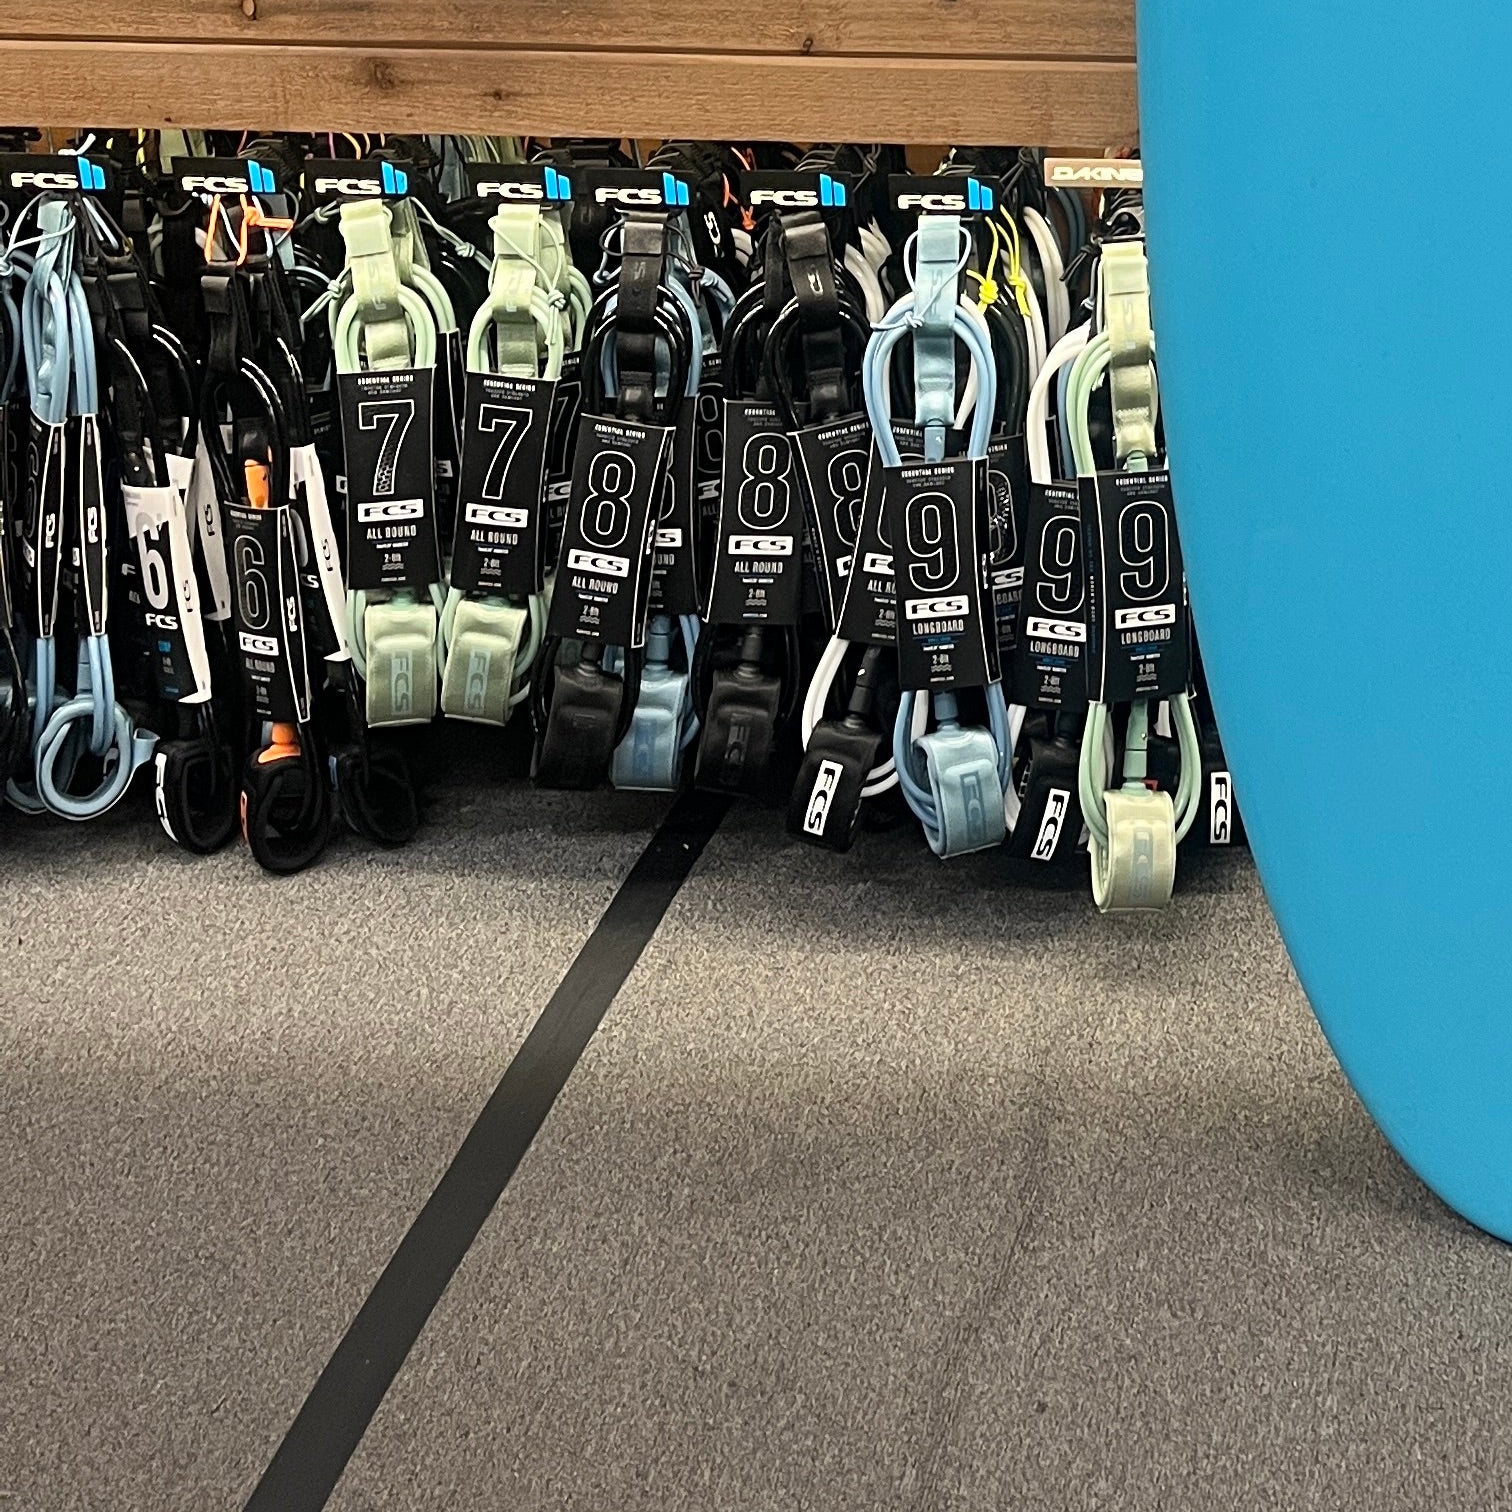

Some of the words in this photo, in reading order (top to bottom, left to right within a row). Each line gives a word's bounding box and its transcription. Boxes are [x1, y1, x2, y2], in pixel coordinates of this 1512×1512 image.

[11, 173, 78, 188] FCS
[182, 176, 249, 193] FCS
[315, 179, 382, 195] FCS
[477, 182, 543, 198] FCS
[596, 187, 662, 205] FCS
[751, 189, 818, 206] FCS
[898, 193, 965, 211] FCS
[358, 400, 414, 495] 7
[479, 403, 532, 499] 7
[738, 433, 791, 529] 8
[580, 450, 635, 548] 8
[364, 504, 419, 517] FCS
[471, 509, 522, 523] FCS
[367, 527, 383, 539] ALL
[385, 525, 417, 538] ROUND
[470, 530, 487, 541] ALL
[489, 532, 518, 545] ROUND
[732, 539, 787, 552] FCS
[906, 492, 960, 592] 9
[1119, 501, 1170, 600] 9
[136, 512, 169, 609] 6
[572, 554, 625, 572] FCS
[735, 562, 750, 574] ALL
[753, 561, 783, 574] ROUND
[1036, 515, 1085, 614] 9
[234, 534, 270, 630] 6
[572, 576, 587, 589] ALL
[588, 579, 618, 594] ROUND
[909, 600, 965, 614] FCS
[145, 613, 178, 629] FCS
[1119, 609, 1173, 624] FCS
[912, 620, 964, 635] LONGBOARD
[1030, 622, 1086, 638] FCS
[242, 637, 275, 651] FCS
[1121, 628, 1171, 645] LONGBOARD
[1030, 641, 1080, 658] LONGBOARD
[809, 765, 838, 832] FCS
[1213, 775, 1229, 841] FCS
[1035, 791, 1067, 857] FCS
